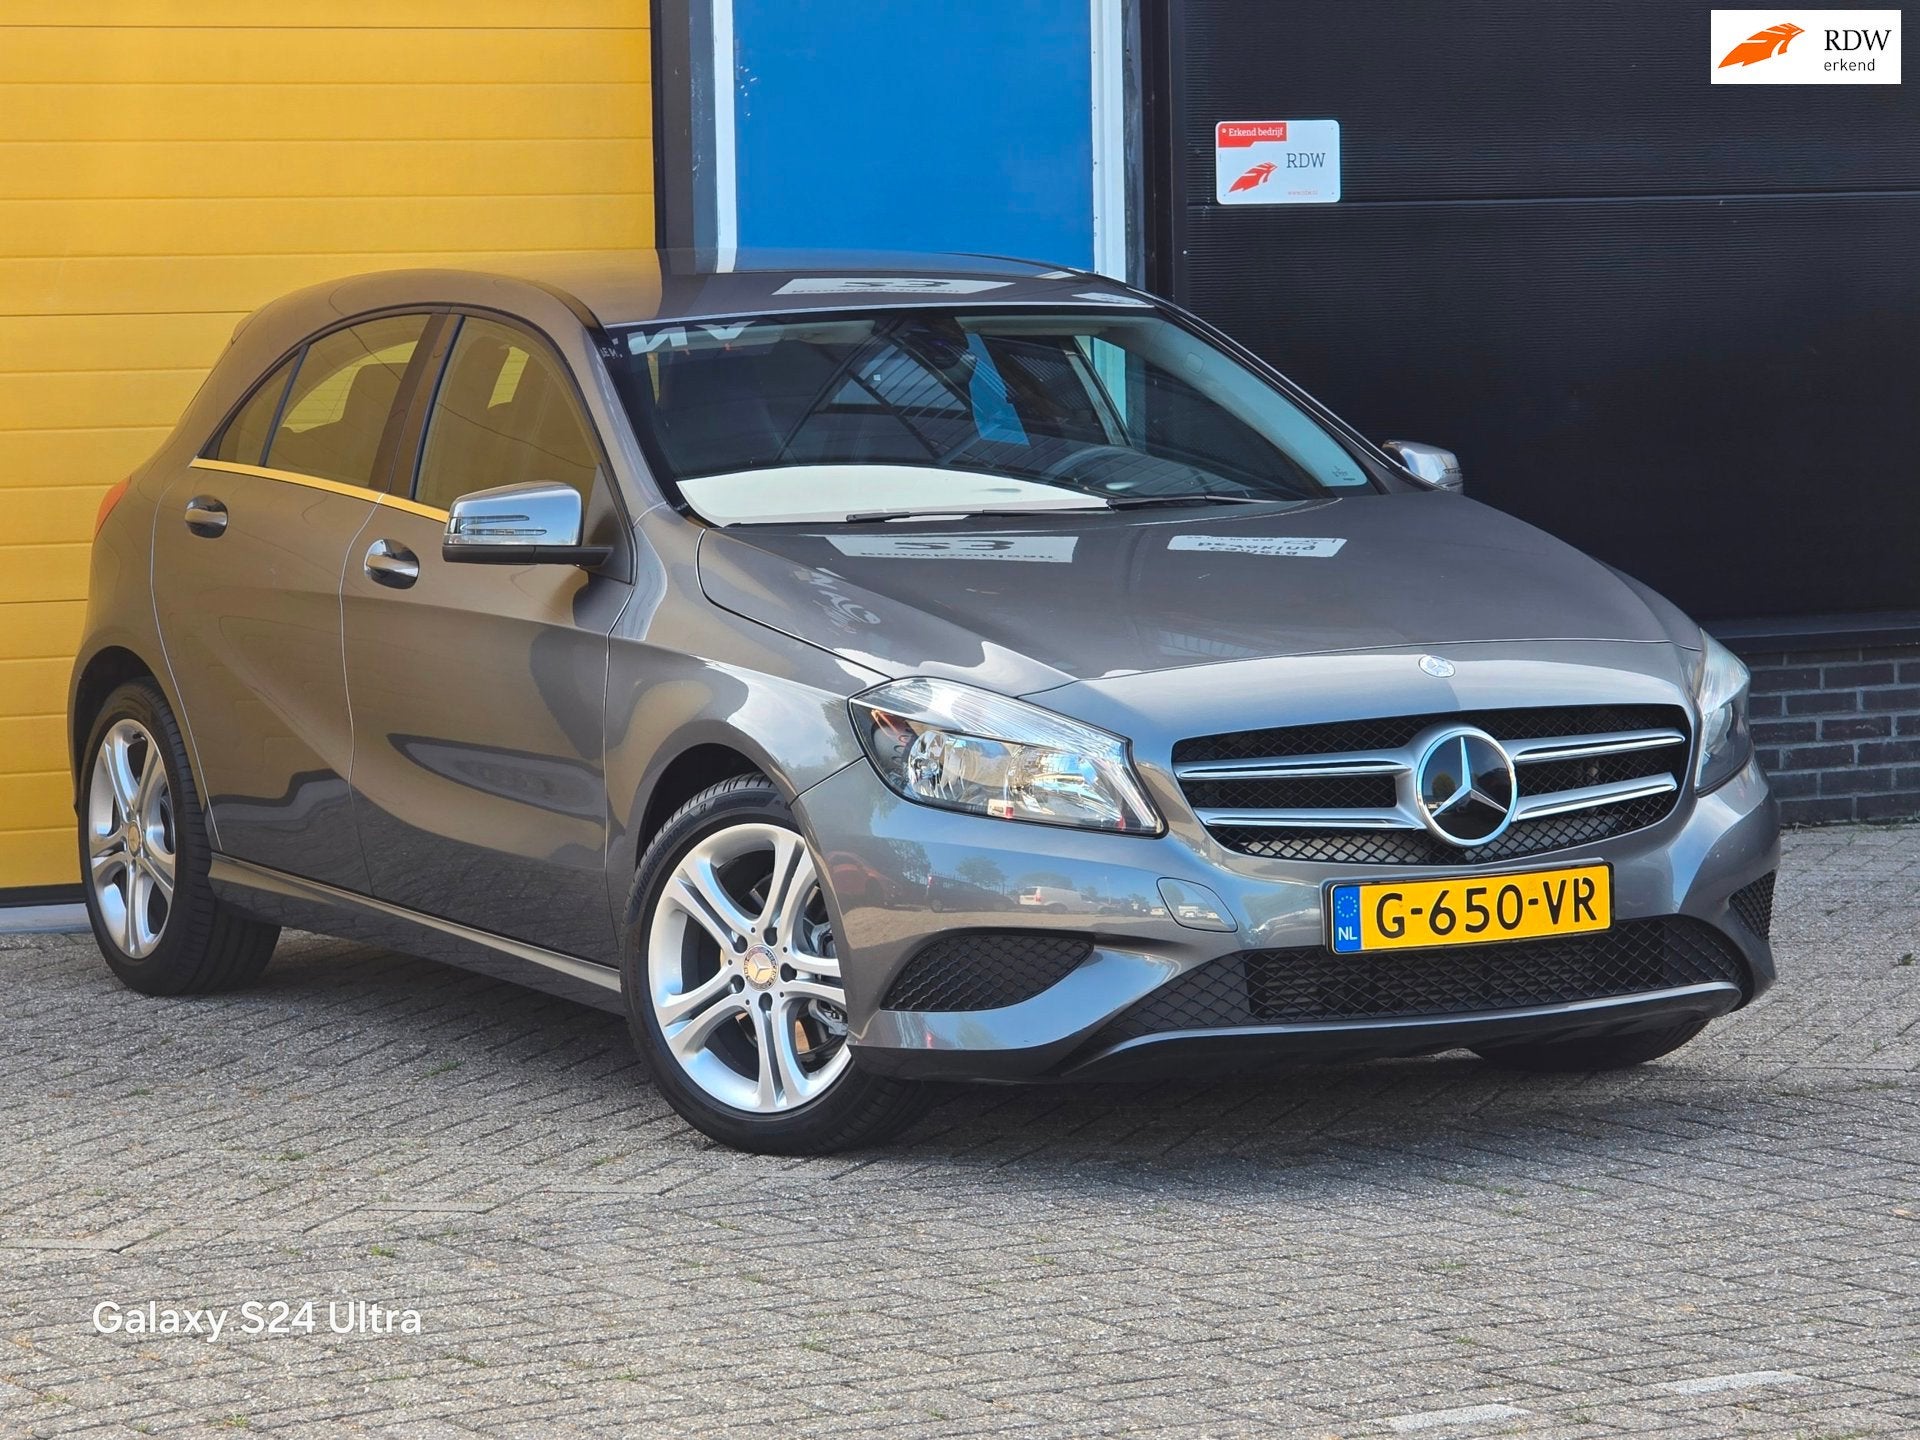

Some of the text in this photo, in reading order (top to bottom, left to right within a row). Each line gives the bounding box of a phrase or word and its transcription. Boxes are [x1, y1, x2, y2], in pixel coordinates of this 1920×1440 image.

[1228, 127, 1284, 138] Erkend bedrijf
[1286, 152, 1326, 169] RDW
[1375, 876, 1597, 939] G-650-VR
[1338, 926, 1358, 941] NL
